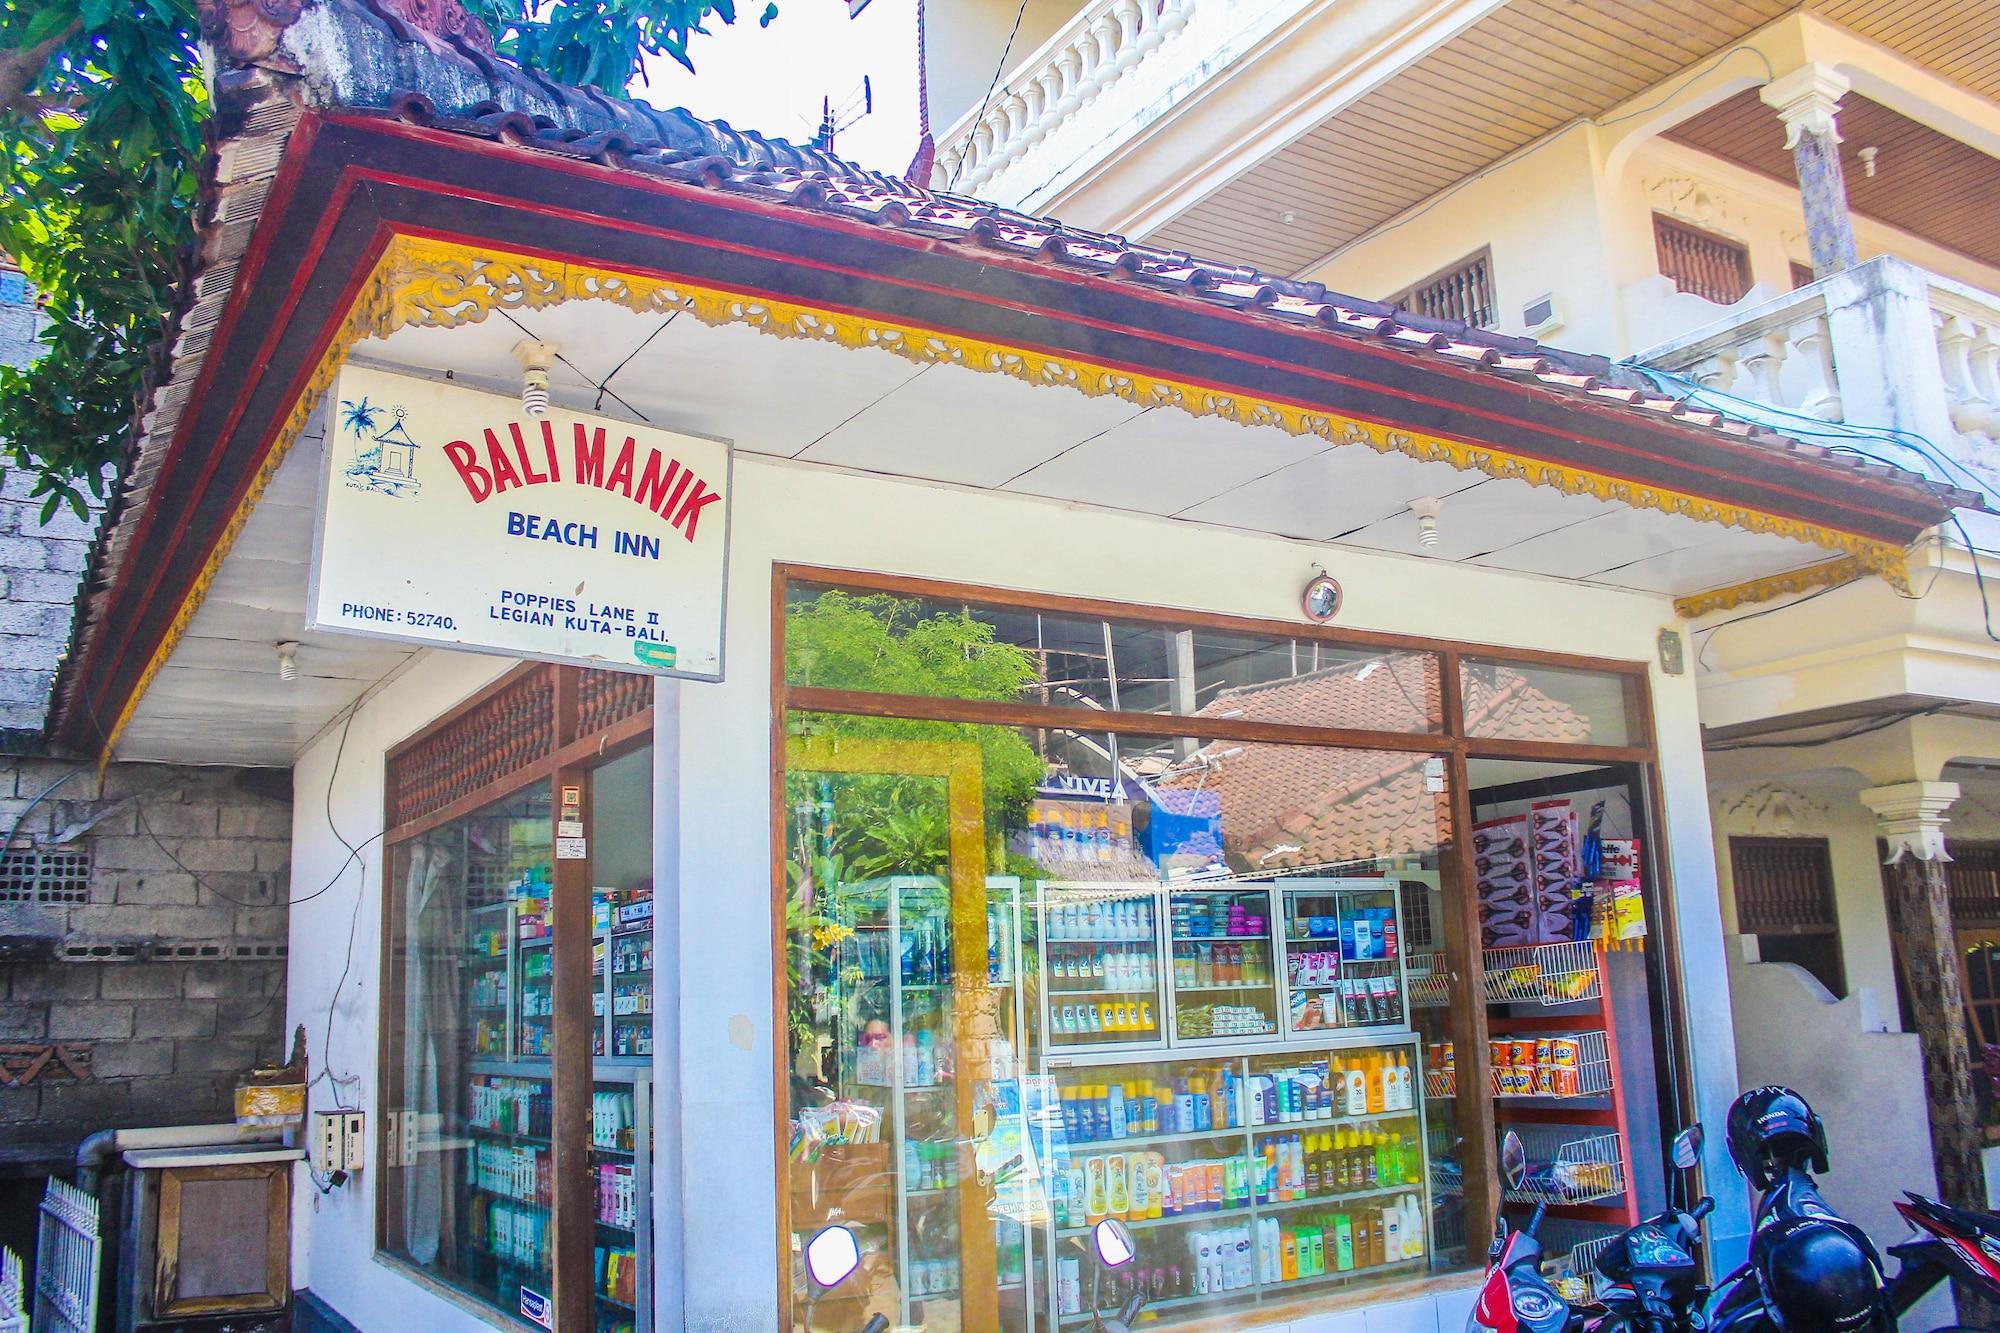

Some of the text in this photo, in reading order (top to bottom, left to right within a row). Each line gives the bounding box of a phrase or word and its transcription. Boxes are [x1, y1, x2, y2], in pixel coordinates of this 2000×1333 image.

[443, 420, 722, 542] BALI MANIK
[507, 511, 661, 560] BEACH INN
[489, 606, 554, 626] LEGIAN
[500, 590, 576, 613] POPPIES
[589, 604, 635, 623] LANE
[1058, 775, 1129, 799] NIVEA
[1756, 1110, 1788, 1125] HONDA
